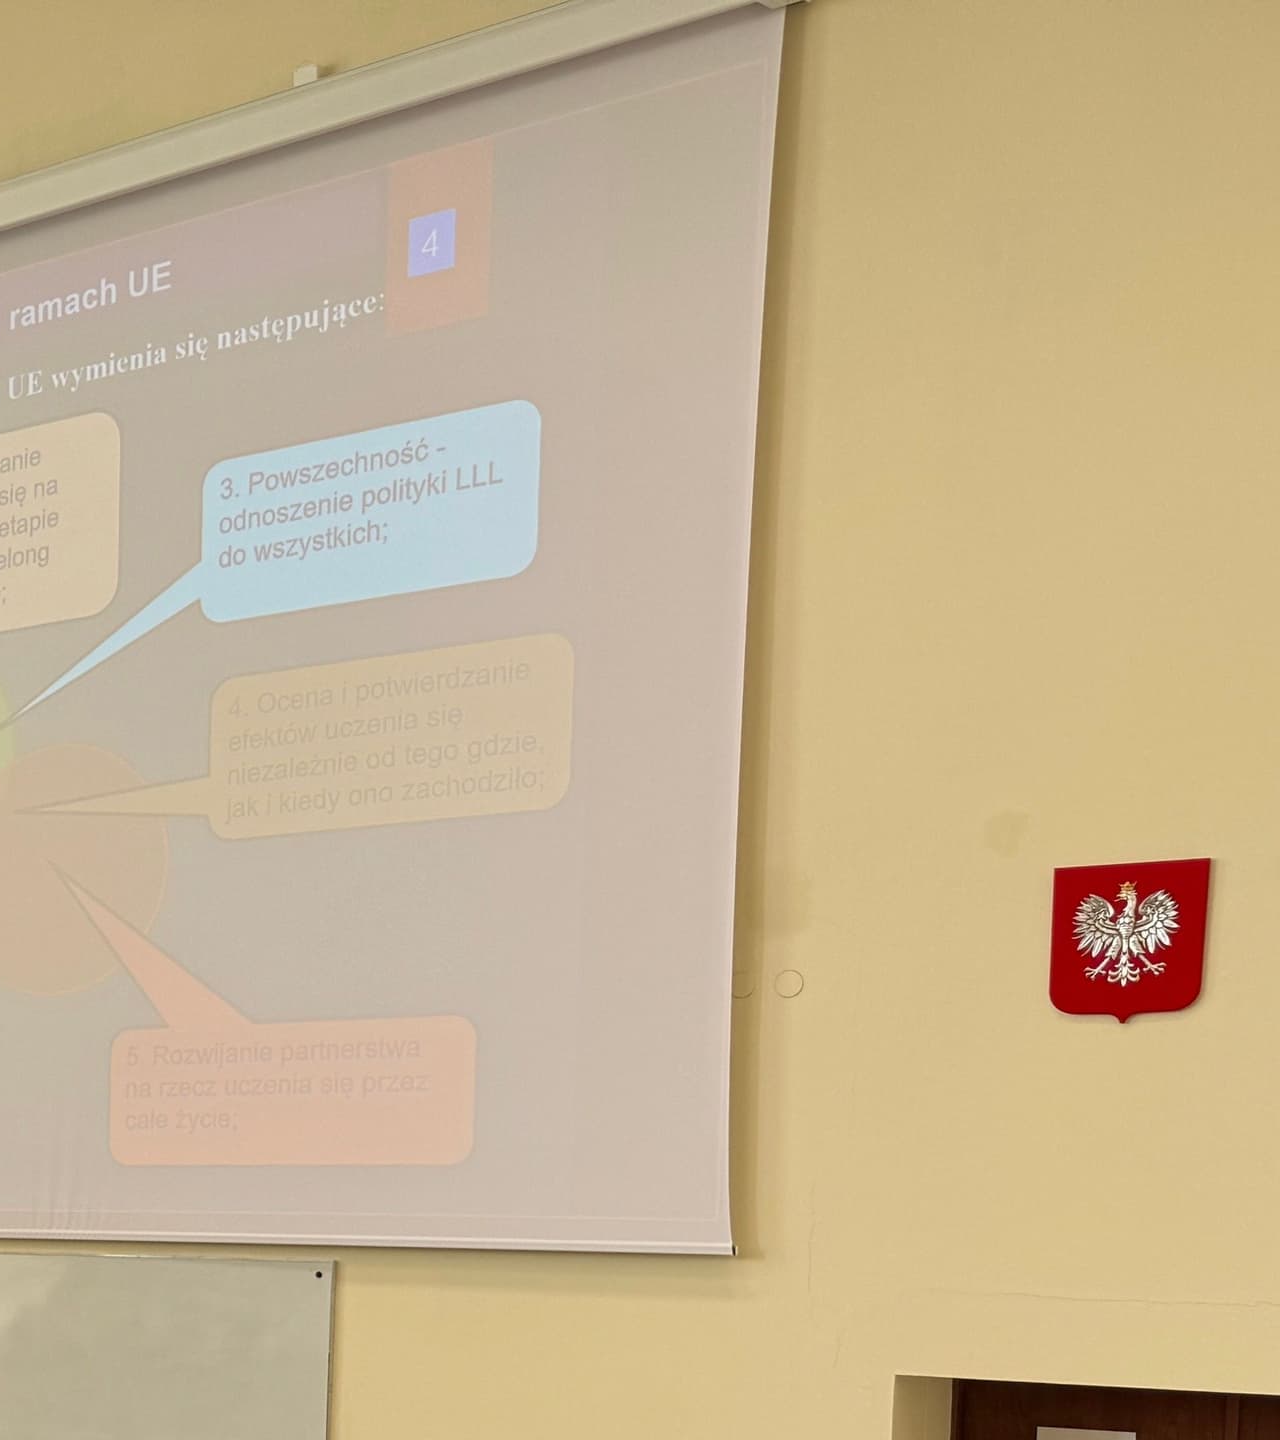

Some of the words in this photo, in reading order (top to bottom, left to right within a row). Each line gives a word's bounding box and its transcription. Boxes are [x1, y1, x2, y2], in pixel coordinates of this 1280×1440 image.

[421, 228, 439, 258] 4
[9, 277, 118, 330] ramach
[128, 261, 173, 298] UE
[8, 370, 43, 400] UE
[52, 347, 167, 393] wymienia
[175, 332, 208, 361] się
[217, 293, 385, 351] następujące:
[220, 477, 240, 500] 3.
[248, 437, 430, 495] Powszechność
[0, 484, 27, 508] się
[34, 479, 58, 499] na
[219, 490, 353, 533] odnoszenie
[362, 469, 447, 515] polityki
[456, 461, 504, 491] LLL
[218, 544, 246, 568] do
[254, 519, 389, 562] wszystkich;
[257, 687, 333, 714] Ocena
[355, 657, 531, 707] potwierdzanie
[228, 723, 319, 752] efektów
[326, 709, 418, 741] uczenia
[426, 705, 464, 732] się
[227, 752, 358, 785] niezależnie
[366, 748, 395, 770] od
[405, 744, 458, 770] tego
[225, 795, 259, 825] jak
[279, 786, 340, 815] kiedy
[348, 786, 393, 807] ono
[152, 1041, 273, 1070] Rozwijanie
[280, 1037, 421, 1068] partnerstwa
[125, 1079, 151, 1098] na
[224, 1074, 312, 1096] uczenia
